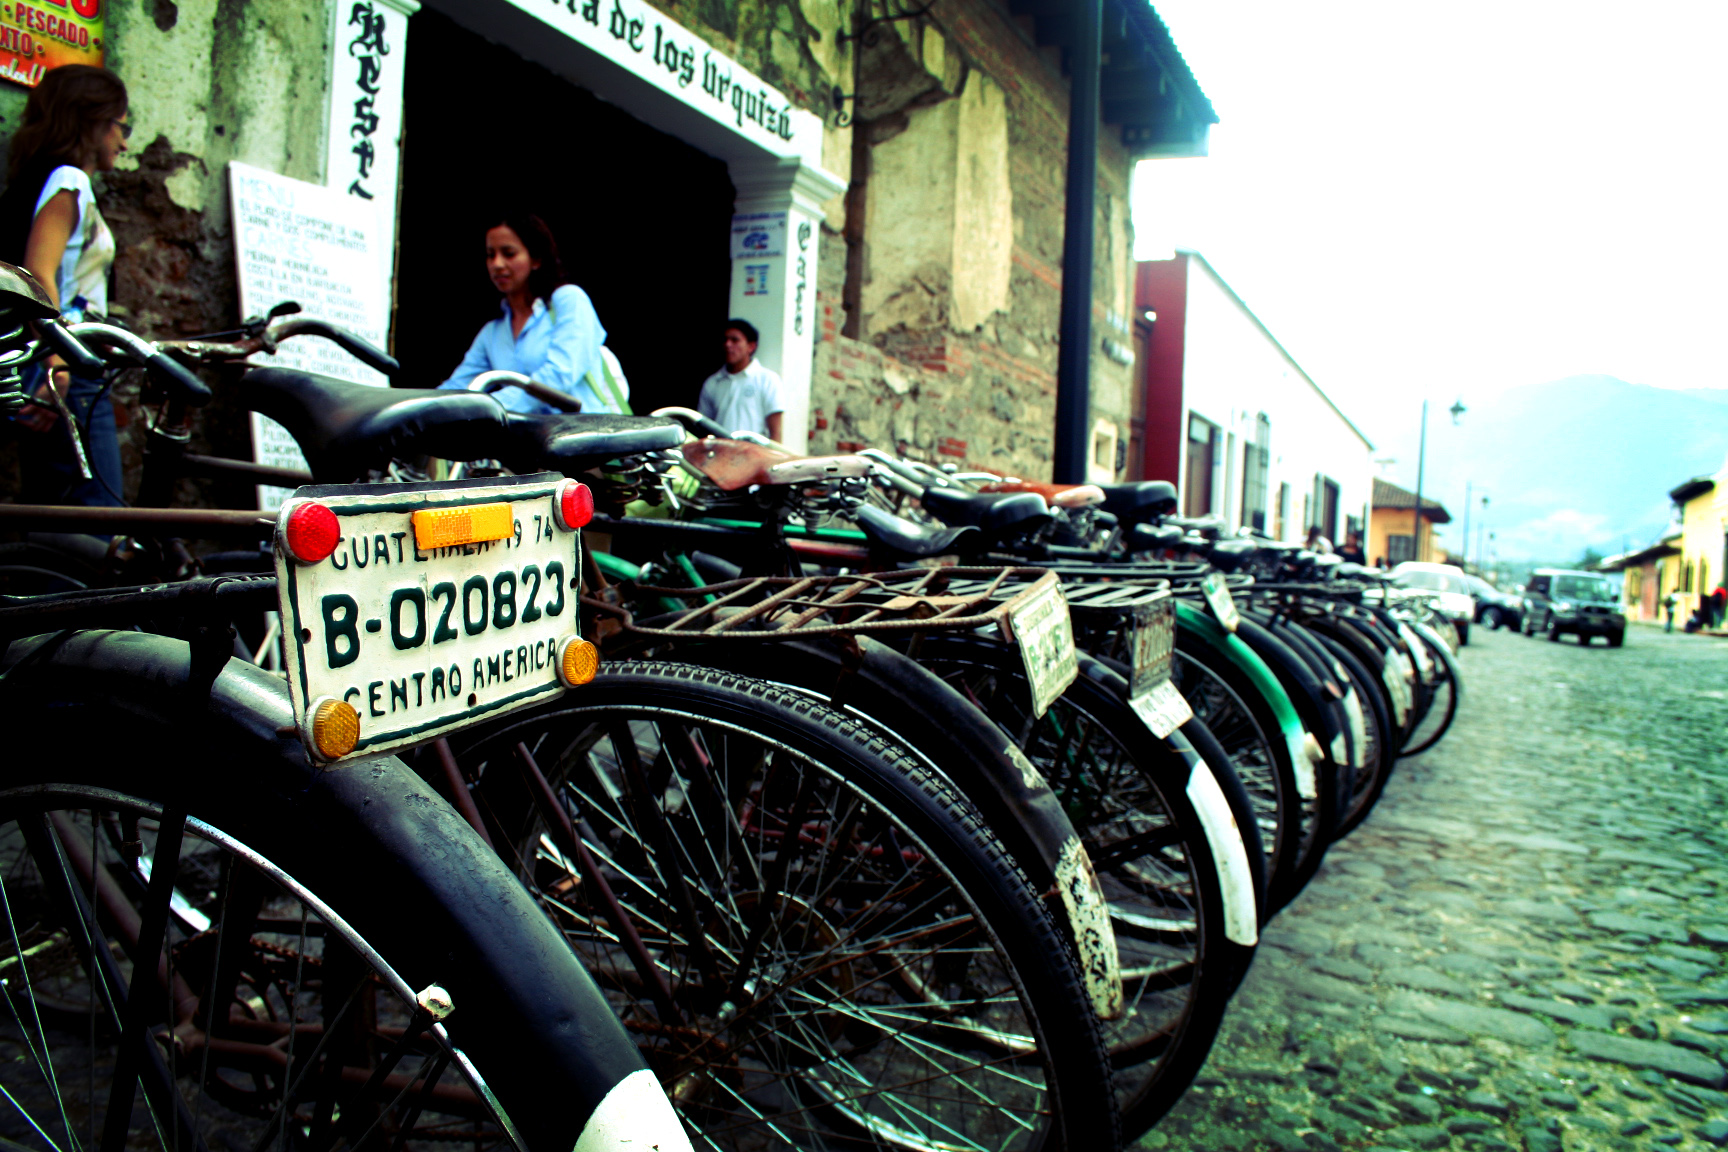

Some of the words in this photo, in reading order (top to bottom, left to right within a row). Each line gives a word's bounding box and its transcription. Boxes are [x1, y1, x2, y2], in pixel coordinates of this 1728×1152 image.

[15, 2, 89, 48] PESCADO
[609, 0, 645, 53] de
[653, 24, 695, 88] los
[533, 514, 554, 543] 74
[321, 561, 565, 669] B-020823
[344, 665, 462, 720] CENTRO
[473, 637, 556, 689] AMERICA
